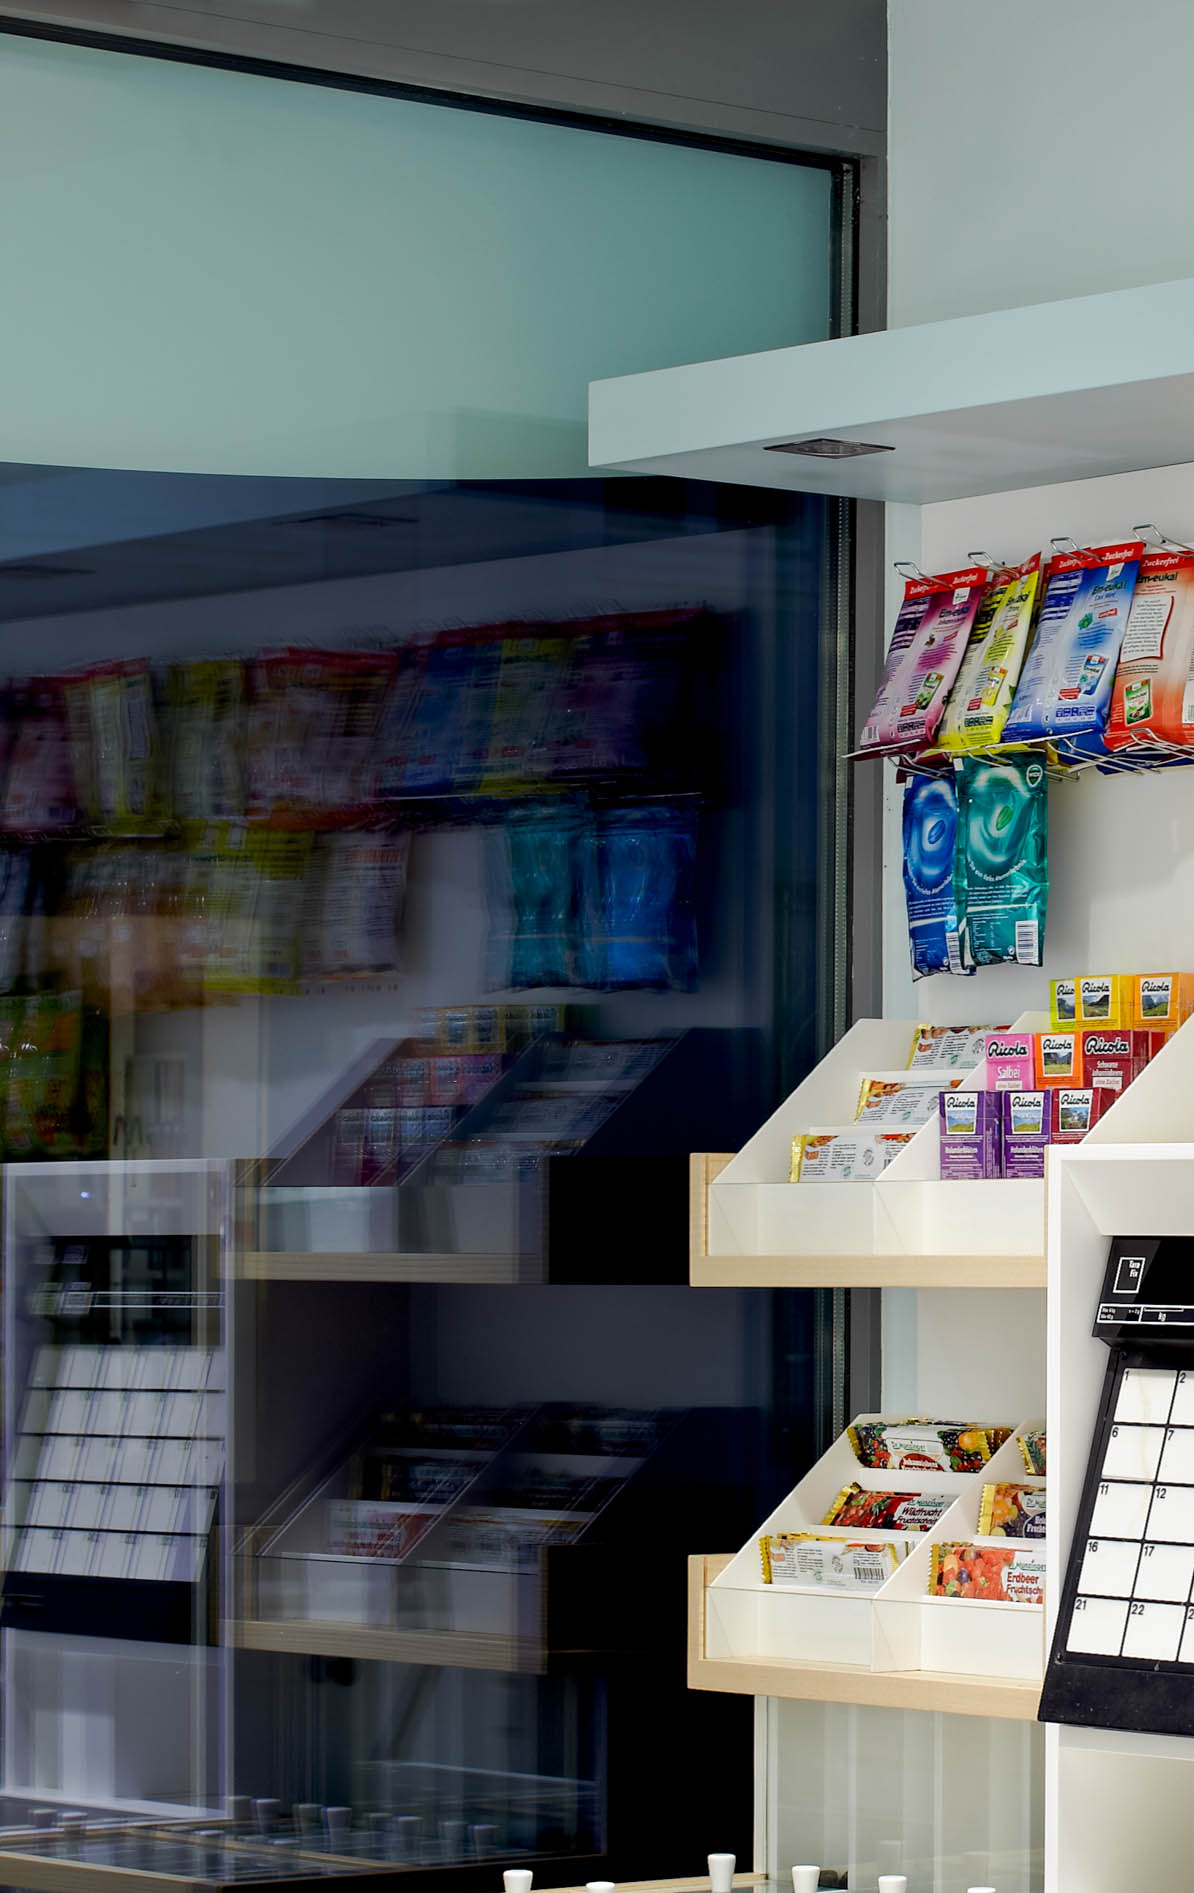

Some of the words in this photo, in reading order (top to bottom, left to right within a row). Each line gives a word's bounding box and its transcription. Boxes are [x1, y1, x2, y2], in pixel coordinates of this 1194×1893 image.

[1142, 556, 1179, 568] Zuckerfrei
[1057, 984, 1075, 996] Rico
[1082, 982, 1110, 993] Ricola
[1142, 981, 1170, 992] Ricola
[988, 1041, 1028, 1057] Ricola
[1043, 1038, 1073, 1050] Ricola
[1085, 1037, 1129, 1053] Ricola
[946, 1096, 976, 1108] Ricola
[1012, 1095, 1042, 1108] Ricola
[1061, 1093, 1091, 1105] Ricola
[1124, 1370, 1129, 1381] 1
[1179, 1372, 1186, 1384] 2
[1111, 1427, 1118, 1438] 6
[1167, 1429, 1175, 1441] 7
[1100, 1483, 1109, 1495] 11
[1156, 1487, 1166, 1499] 12
[902, 1506, 943, 1516] Wildfrucht
[1087, 1541, 1098, 1553] 16
[1144, 1545, 1154, 1557] 17
[1006, 1571, 1039, 1583] Erdbeer
[1006, 1583, 1043, 1595] Fruchtsch
[1075, 1599, 1086, 1611] 21
[1131, 1603, 1145, 1616] 22
